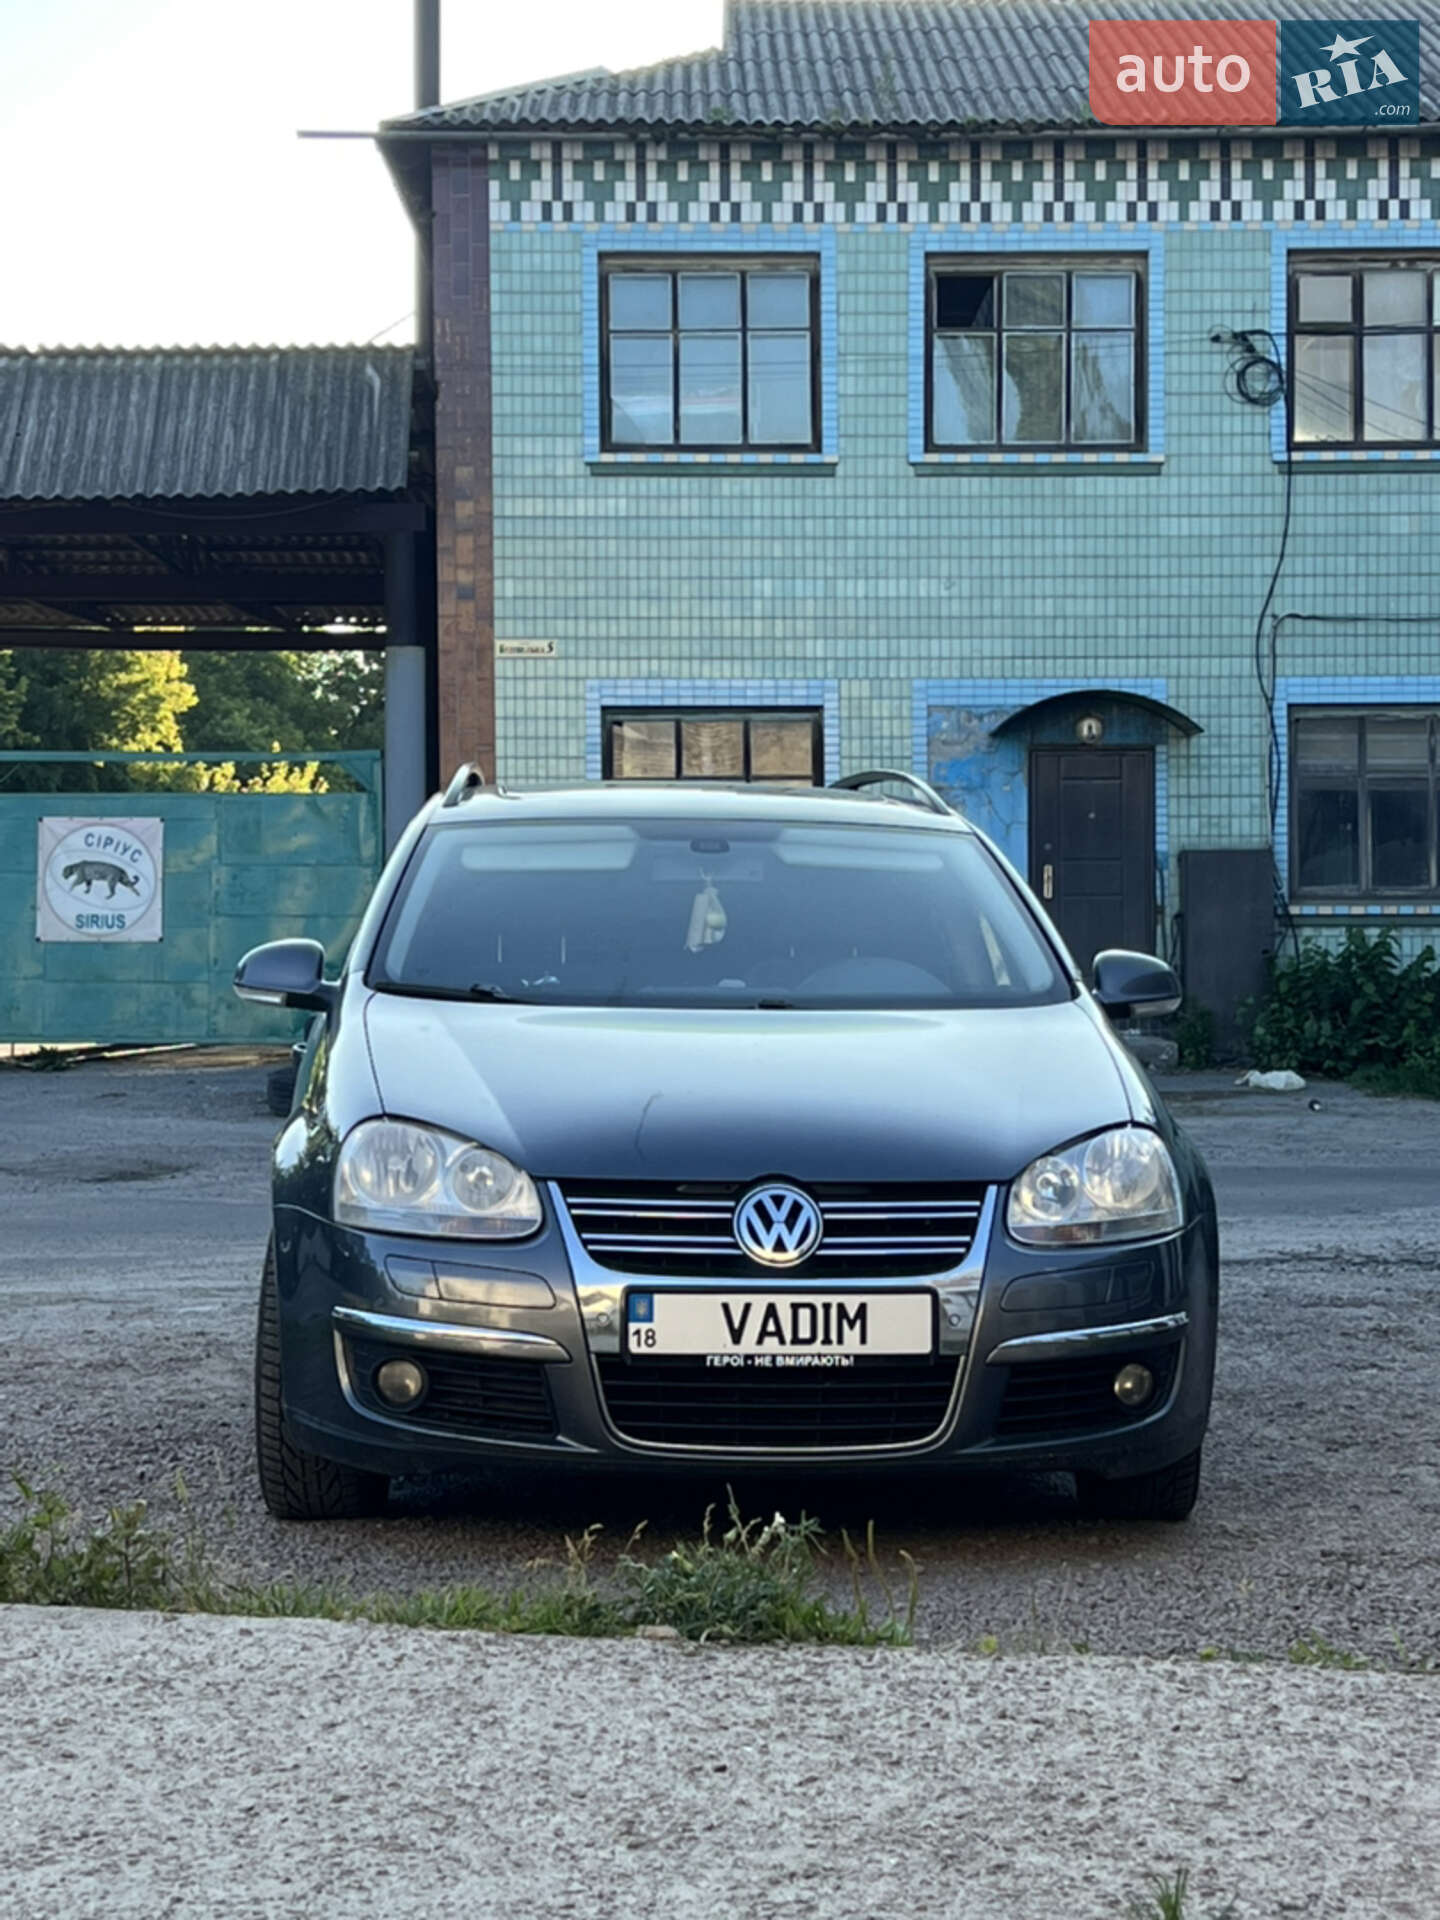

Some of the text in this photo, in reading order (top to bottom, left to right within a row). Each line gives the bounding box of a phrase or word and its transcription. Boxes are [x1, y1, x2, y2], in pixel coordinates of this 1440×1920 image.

[84, 832, 143, 864] СІРІУС
[75, 913, 127, 930] SIRIUS
[720, 1302, 868, 1346] VADIM
[632, 1327, 657, 1349] 18
[754, 1355, 773, 1367] НЕ
